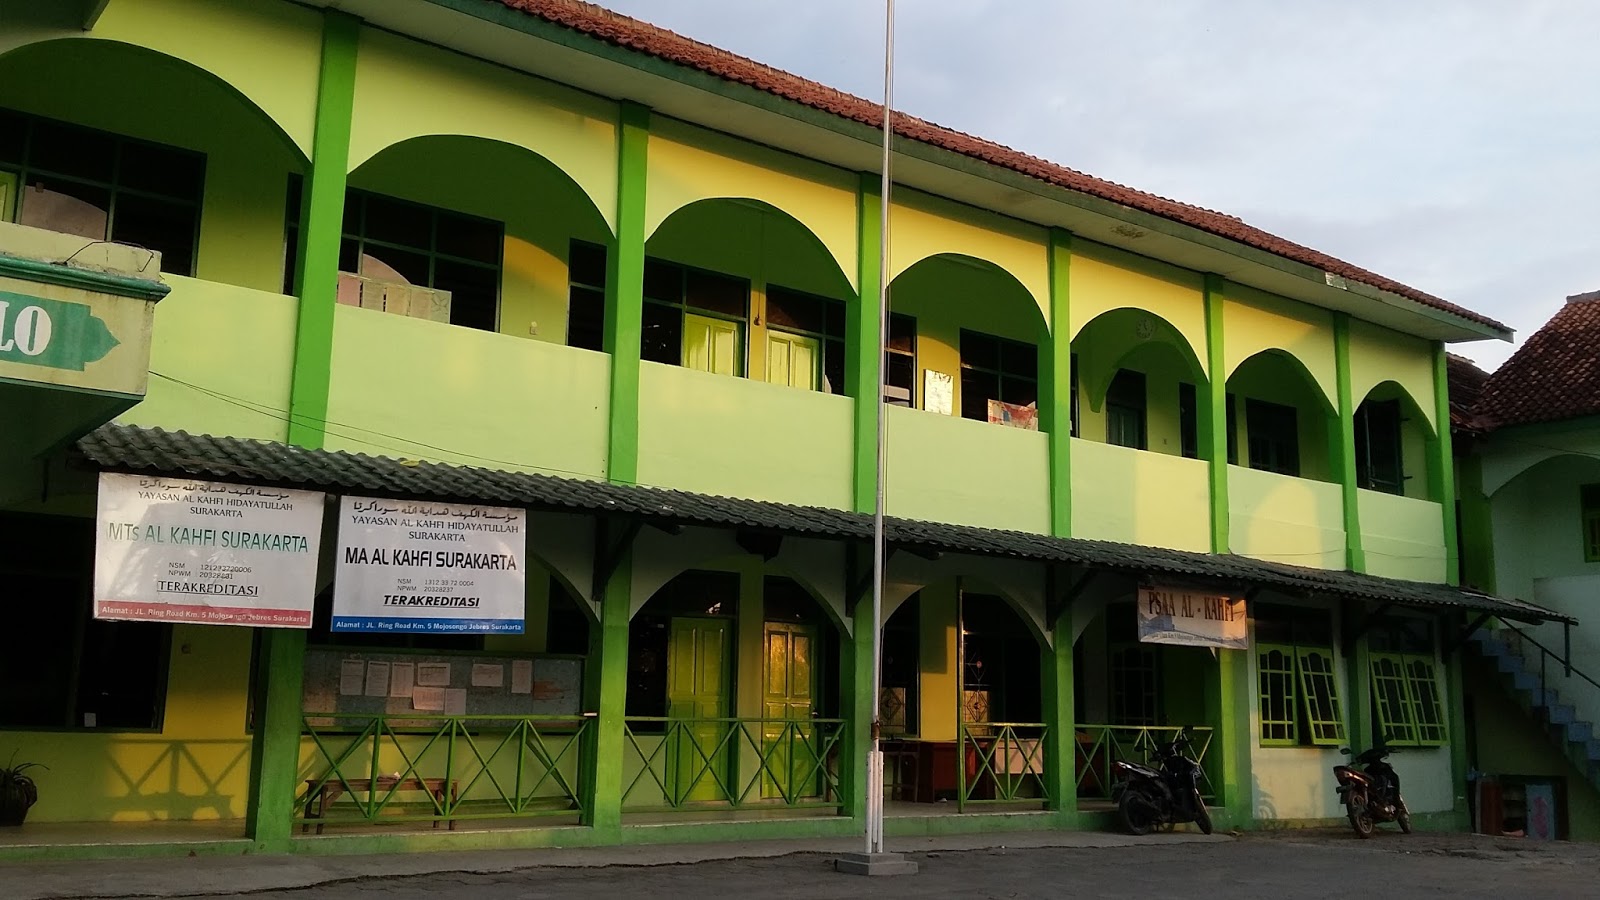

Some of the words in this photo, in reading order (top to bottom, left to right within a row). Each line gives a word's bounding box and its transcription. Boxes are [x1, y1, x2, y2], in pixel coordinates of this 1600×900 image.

[138, 491, 180, 502] YAYASAN
[183, 495, 194, 503] AL
[197, 496, 224, 505] KAHFI
[226, 499, 293, 510] HIDAYATULLAH
[190, 507, 243, 518] SURAKARTA
[419, 508, 449, 516] هداية
[452, 508, 480, 520] الكهف
[482, 513, 518, 522] مؤسسة
[352, 516, 397, 526] YAYASAN
[401, 519, 413, 527] AL
[416, 520, 444, 528] KAHFI
[448, 522, 519, 533] HIDAYATULLAH
[108, 522, 139, 541] MTs
[144, 525, 164, 543] AL
[171, 526, 216, 547] KAHFI
[221, 530, 309, 553] SURAKARTA
[409, 531, 465, 542] SURAKARTA
[345, 547, 368, 564] MA
[371, 548, 389, 565] AL
[393, 550, 432, 567] KAHFI
[436, 551, 517, 570] SURAKARTA
[157, 580, 259, 596] TERAKREDITASI
[383, 595, 480, 608] TERAKREDITASI
[1149, 592, 1175, 616] PSAA
[1181, 595, 1194, 617] AL
[1204, 596, 1234, 621] KAHFI
[101, 606, 128, 614] Alamat
[148, 609, 164, 618] Ring
[248, 613, 271, 621] Jebres
[273, 614, 307, 622] Surakarta
[433, 623, 467, 631] Mojosongo
